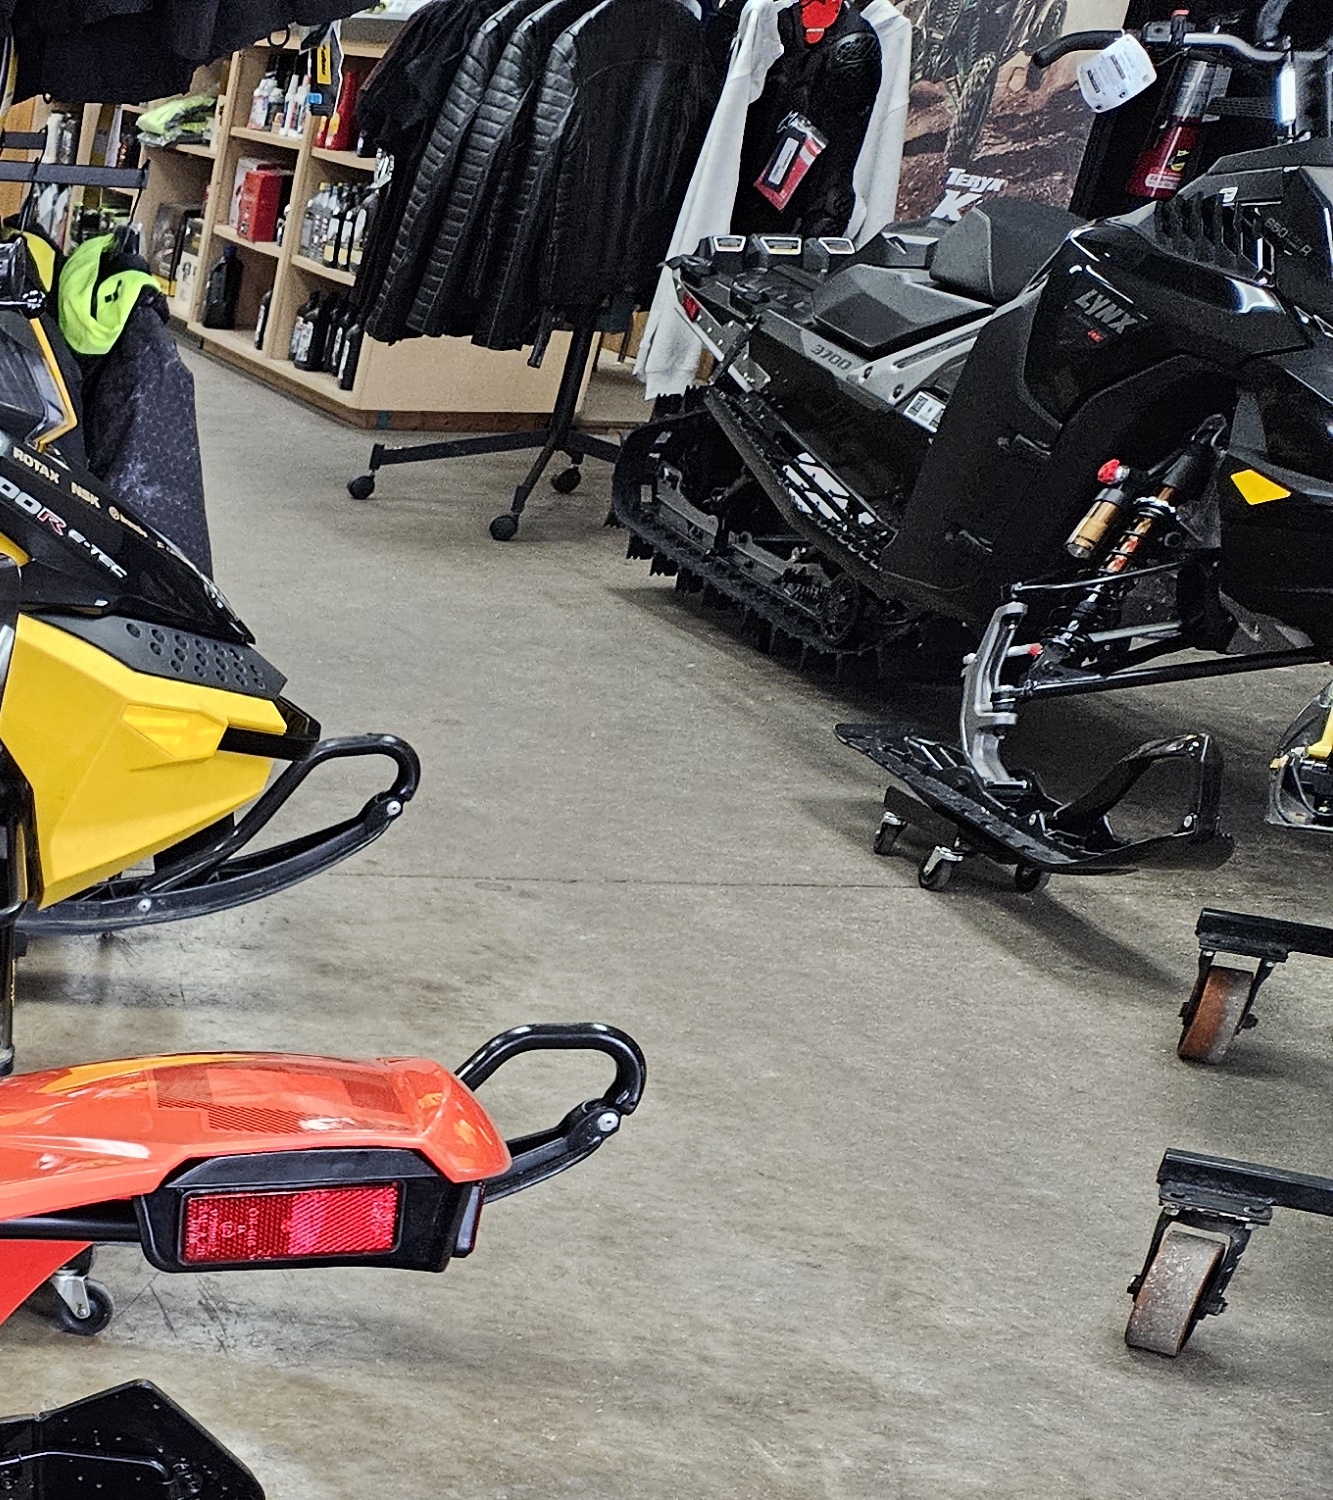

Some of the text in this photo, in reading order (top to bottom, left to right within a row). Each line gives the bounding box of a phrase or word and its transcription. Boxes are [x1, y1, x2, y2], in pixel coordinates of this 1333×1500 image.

[1074, 288, 1138, 334] LYNX
[811, 344, 853, 371] 3700
[13, 446, 60, 484] ROTAX
